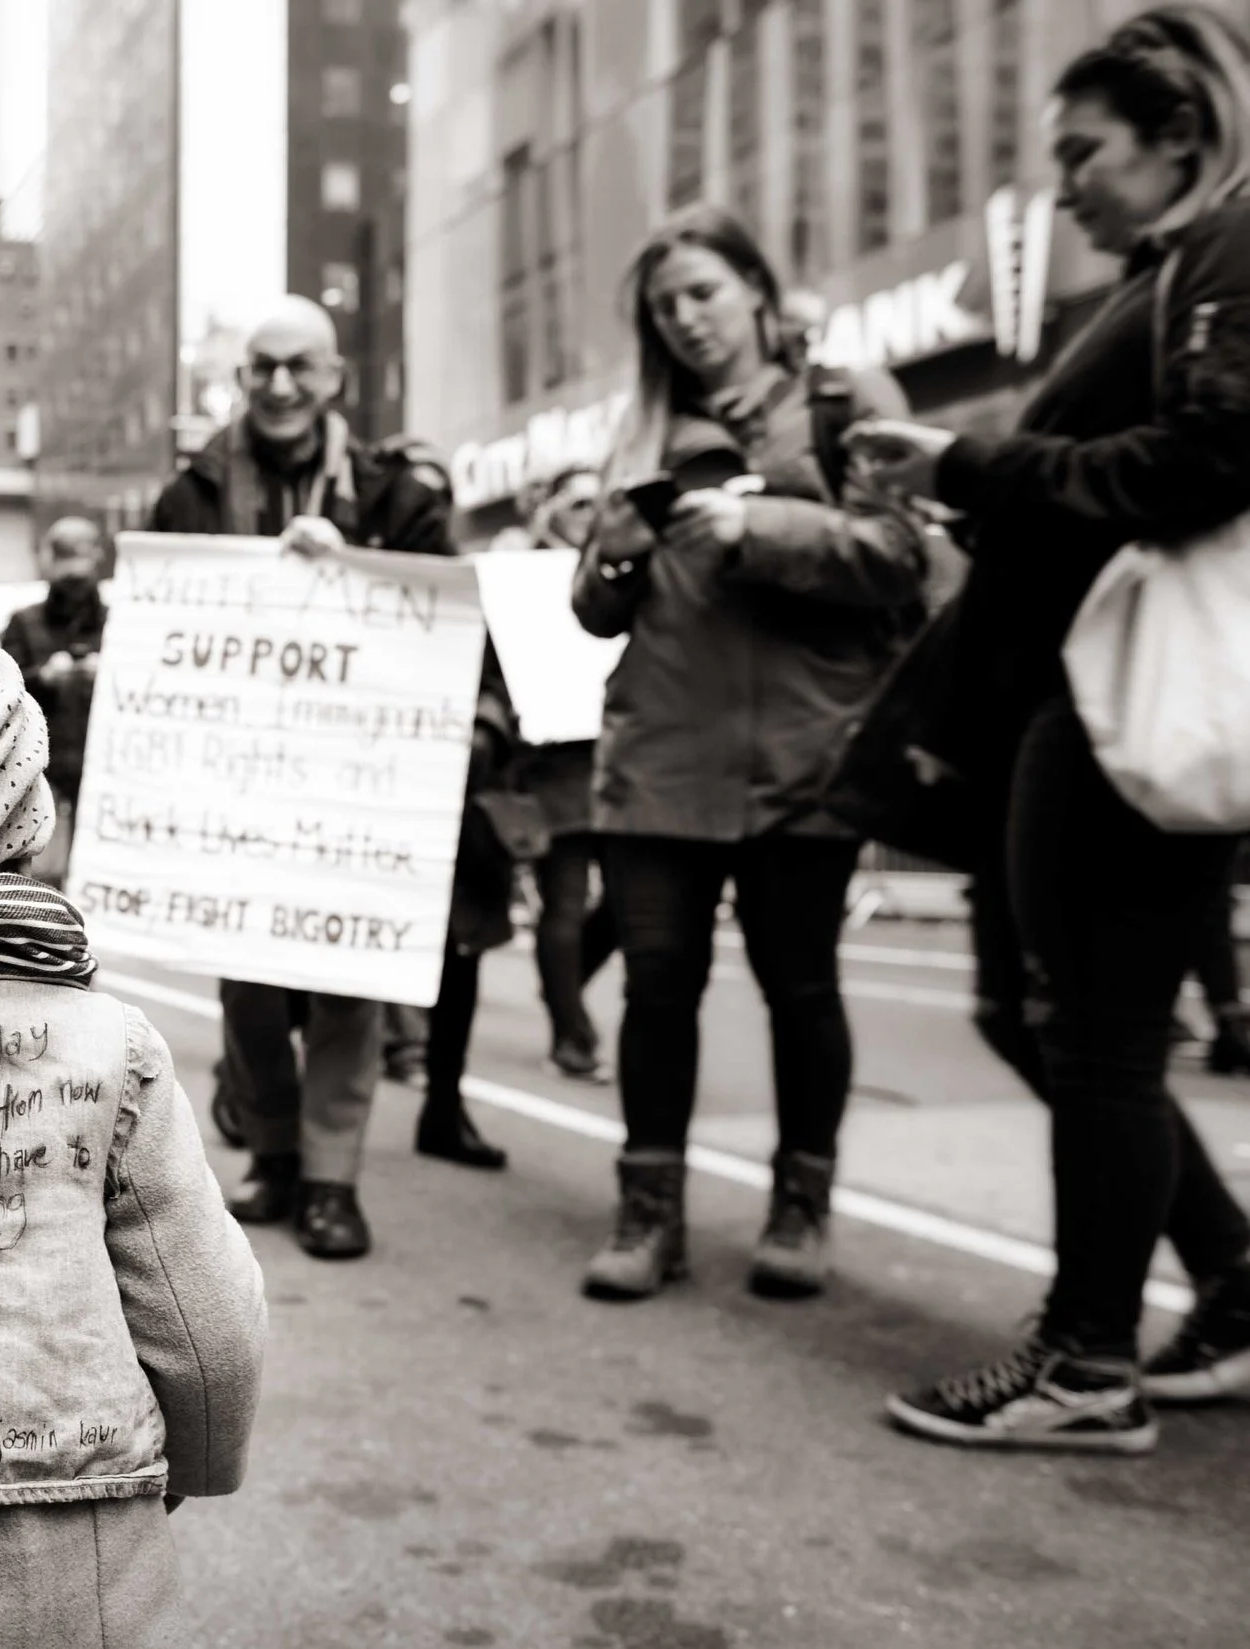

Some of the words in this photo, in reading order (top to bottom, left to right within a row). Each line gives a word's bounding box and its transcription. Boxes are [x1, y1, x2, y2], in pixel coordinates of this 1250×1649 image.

[300, 562, 440, 633] MEN
[161, 631, 360, 684] SUPPORT
[111, 669, 241, 722] Women
[167, 891, 250, 935] FIGHT
[270, 904, 414, 952] BIGOTRY
[58, 1079, 103, 1105] now
[66, 1134, 91, 1170] to
[79, 1420, 117, 1448] kaur
